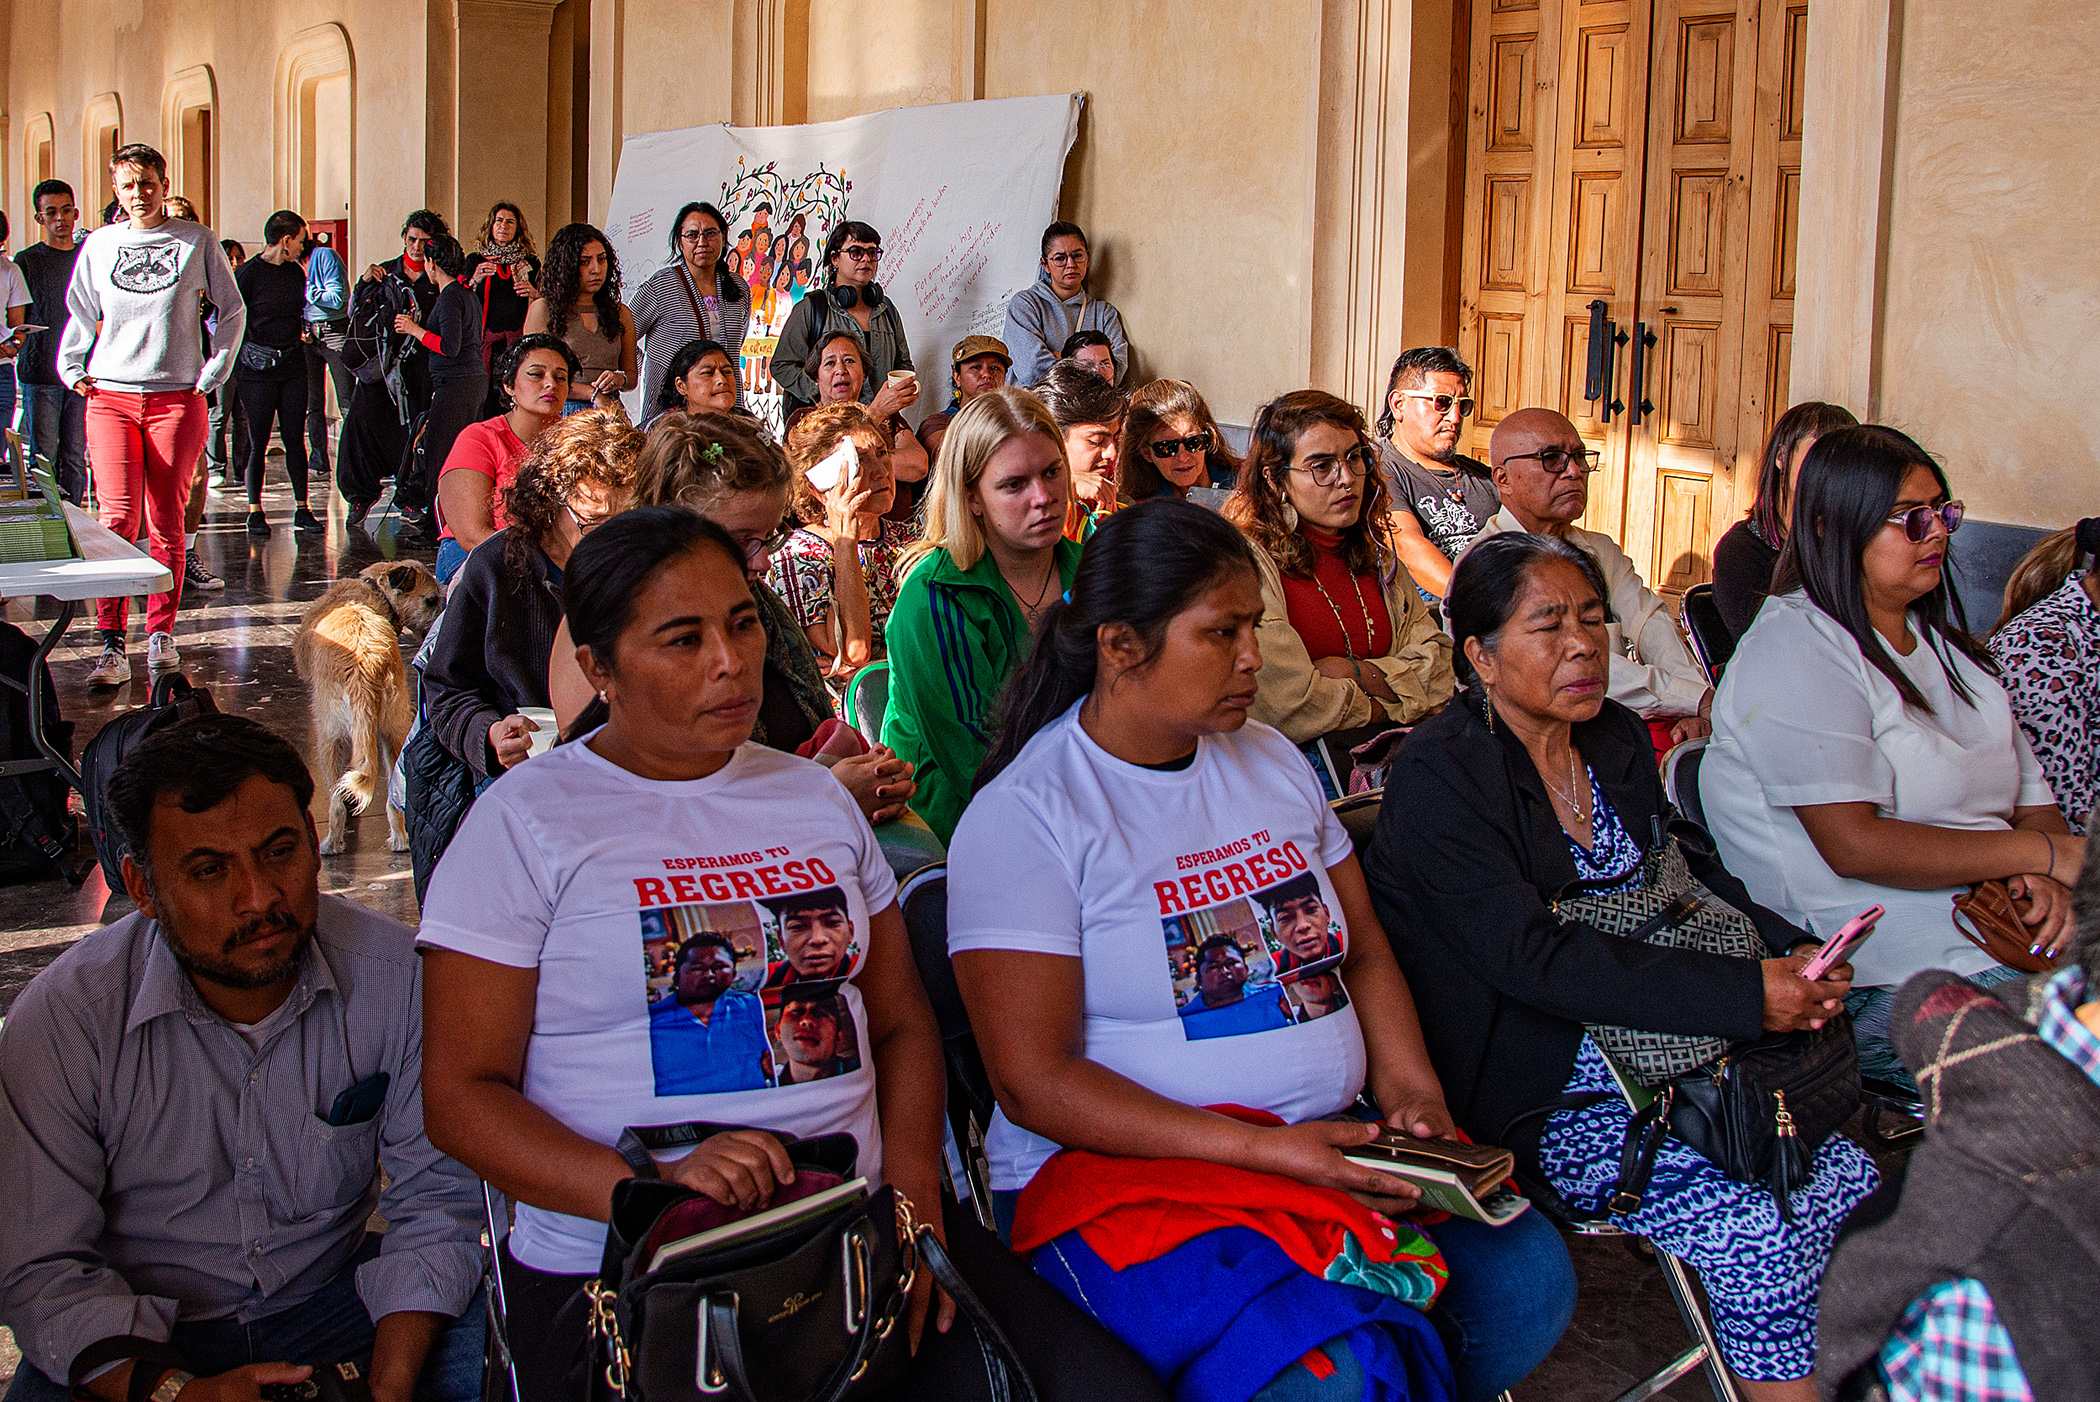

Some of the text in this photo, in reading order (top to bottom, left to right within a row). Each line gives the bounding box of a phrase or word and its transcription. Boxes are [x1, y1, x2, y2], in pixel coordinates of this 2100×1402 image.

[914, 278, 928, 295] Por
[959, 226, 972, 243] hijo
[662, 846, 790, 870] ESPERAMOS TU
[1176, 829, 1271, 870] ESPERAMOS TU
[633, 857, 836, 907] REGRESO
[1153, 840, 1308, 915] REGRESO
